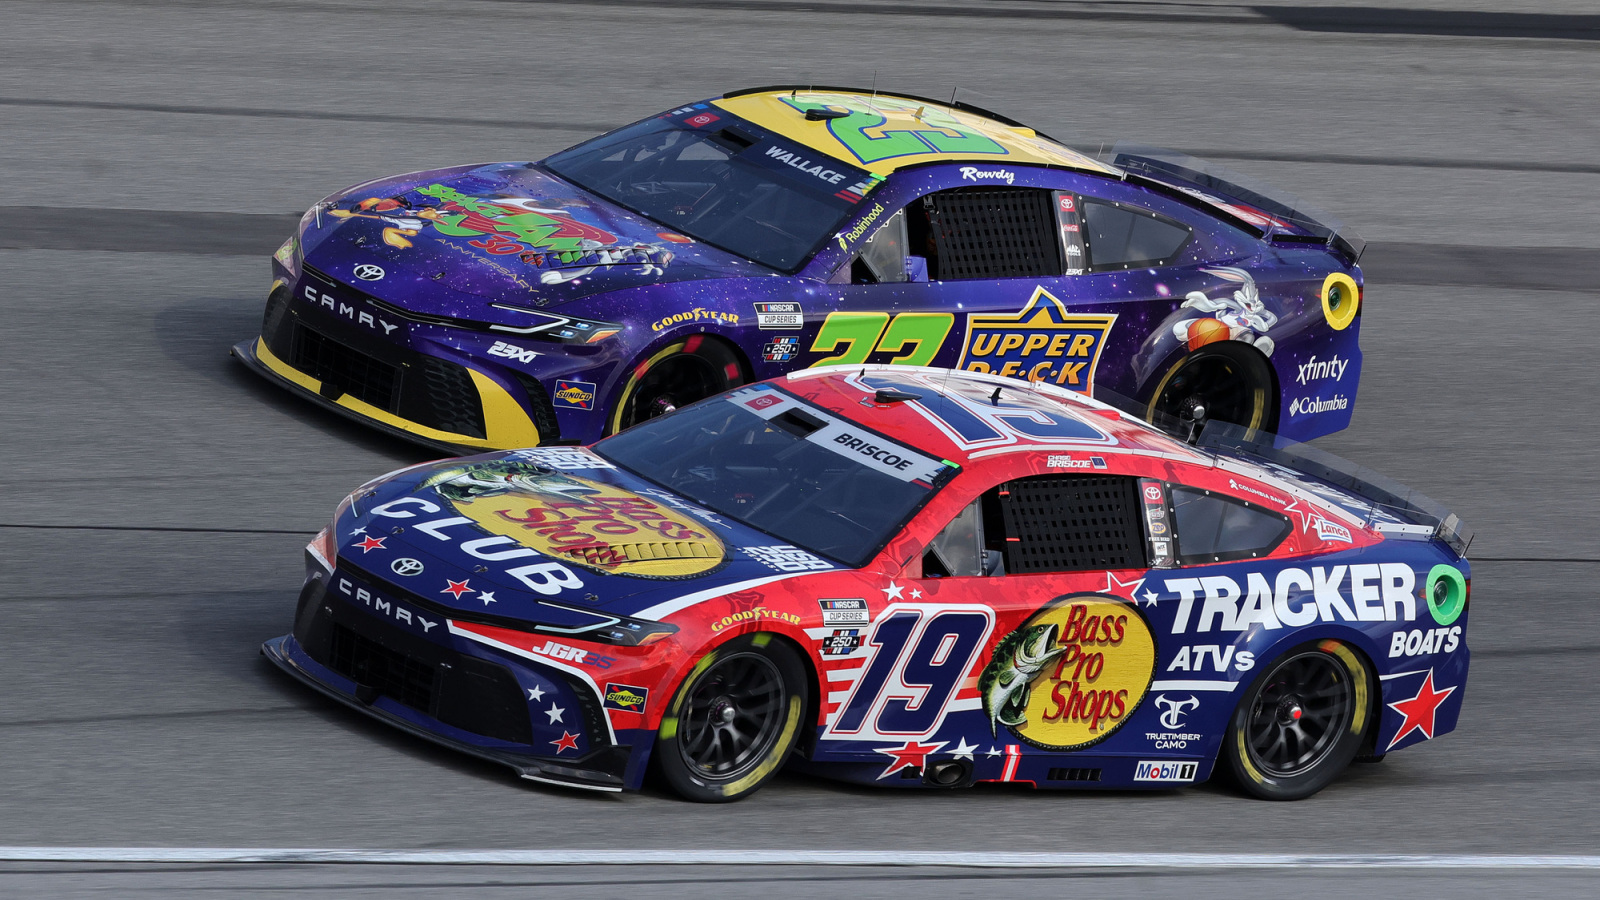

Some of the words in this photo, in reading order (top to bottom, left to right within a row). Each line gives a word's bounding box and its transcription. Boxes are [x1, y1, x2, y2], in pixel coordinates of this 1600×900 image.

[777, 94, 1009, 165] 23
[765, 146, 846, 184] WALLACE
[959, 166, 1015, 185] Rowdy
[416, 183, 514, 218] SPACE
[845, 202, 885, 243] Robinhood
[435, 238, 539, 293] ANNIVERSARY
[304, 285, 399, 336] CAMRY
[769, 304, 795, 312] NASCAR
[777, 316, 797, 324] SERIES
[771, 345, 790, 354] 250
[970, 333, 1095, 357] UPPER
[1295, 354, 1349, 386] xfinity
[558, 391, 591, 400] SUNOCO
[1299, 394, 1348, 414] Columbia
[833, 433, 914, 471] BRISCOE
[1047, 460, 1091, 468] BRISCOE
[1238, 483, 1269, 500] COLUMBIA
[1269, 496, 1287, 506] BANK
[585, 496, 706, 540] Bass
[1320, 519, 1349, 539] Lance
[370, 497, 584, 596] CLUB
[743, 546, 808, 571] 250
[770, 545, 834, 570] USA
[339, 577, 438, 633] CAMRY
[834, 601, 860, 609] NASCAR
[1164, 562, 1416, 634] TRACKER
[829, 612, 842, 620] CUP
[843, 612, 863, 620] SERIES
[1057, 604, 1129, 643] Bass
[831, 636, 852, 646] 250
[1388, 626, 1462, 658] BOATS
[1051, 644, 1104, 680] Pro
[1166, 645, 1255, 672] ATVs
[820, 602, 997, 742] 19
[608, 693, 643, 705] SUNOCO
[1042, 680, 1129, 731] Shops
[1155, 741, 1187, 749] CAMO
[1137, 763, 1179, 779] Mobil
